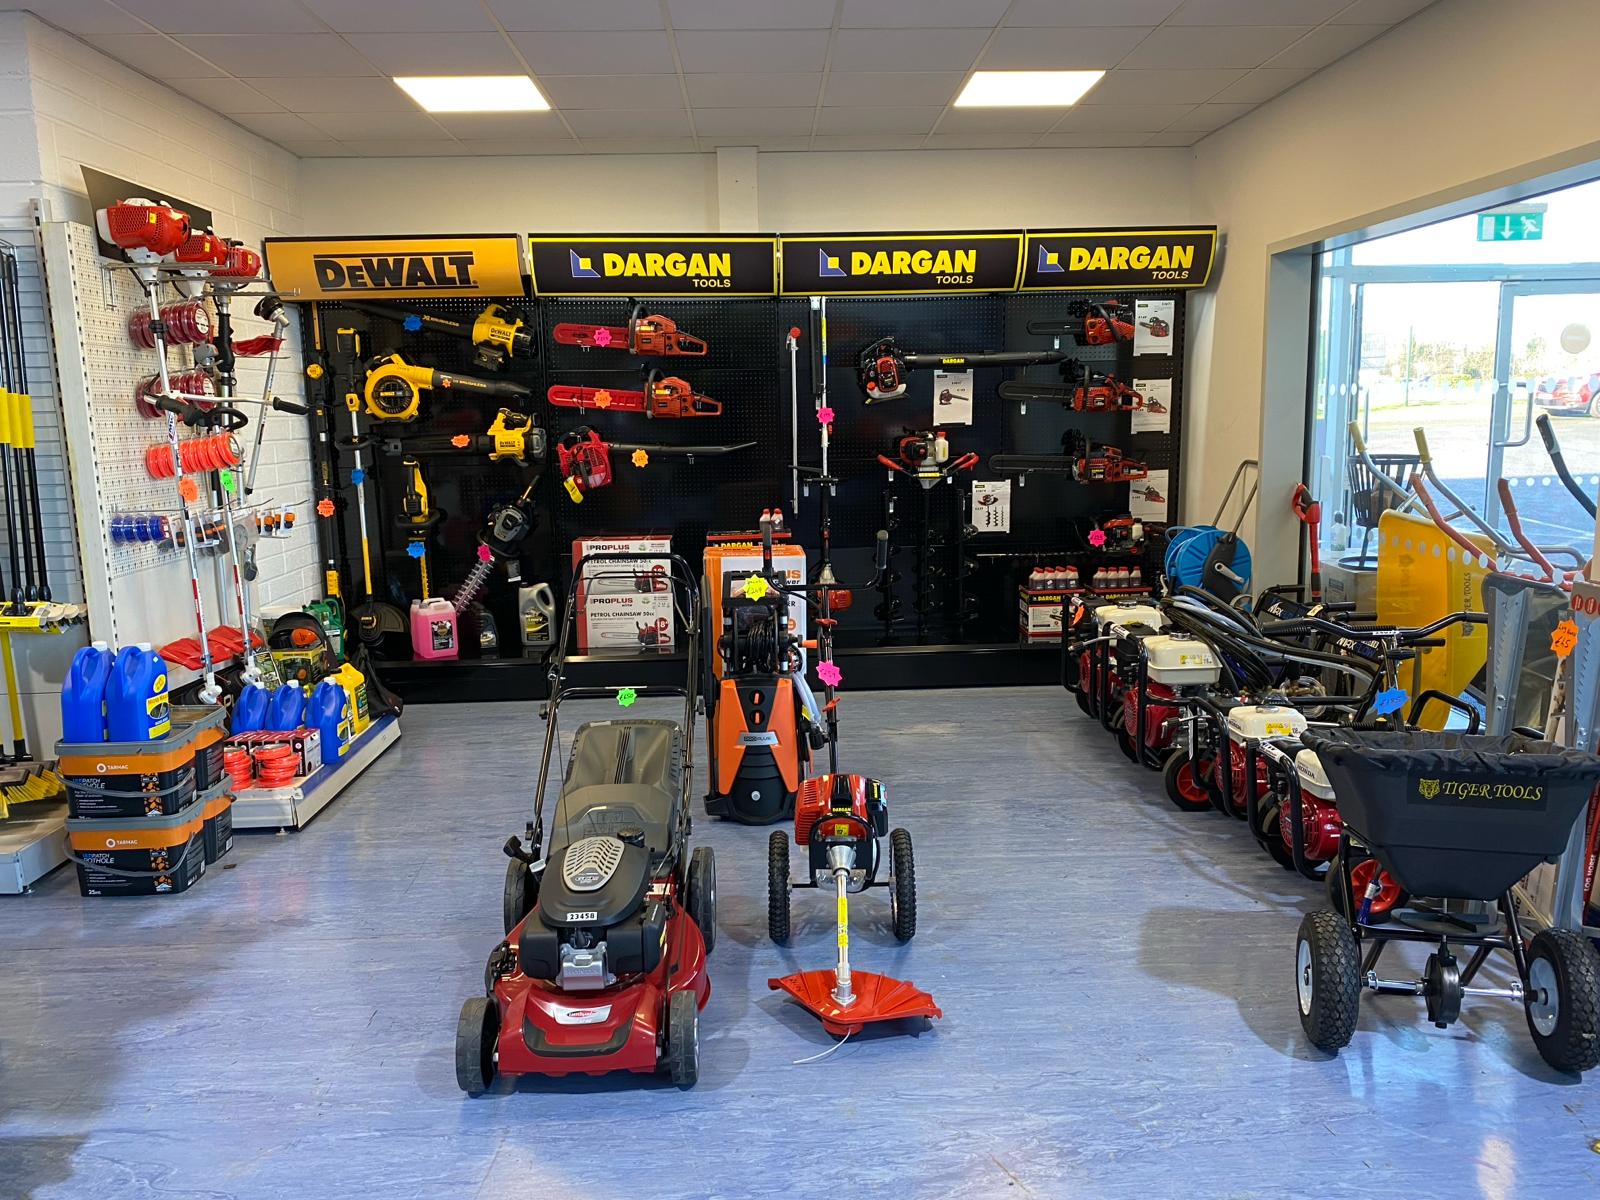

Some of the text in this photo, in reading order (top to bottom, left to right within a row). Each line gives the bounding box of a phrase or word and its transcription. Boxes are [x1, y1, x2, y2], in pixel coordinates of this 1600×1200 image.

[603, 252, 731, 277] DARGAN
[851, 249, 977, 275] DARGAN
[1068, 245, 1195, 271] DARGAN
[692, 279, 731, 288] TOOLS
[935, 275, 974, 284] TOOLS
[1151, 270, 1189, 280] TOOLS
[1297, 764, 1316, 779] HONDA
[1442, 781, 1543, 800] TIGER TOOLS
[1583, 854, 1596, 892] LOG HORSE
